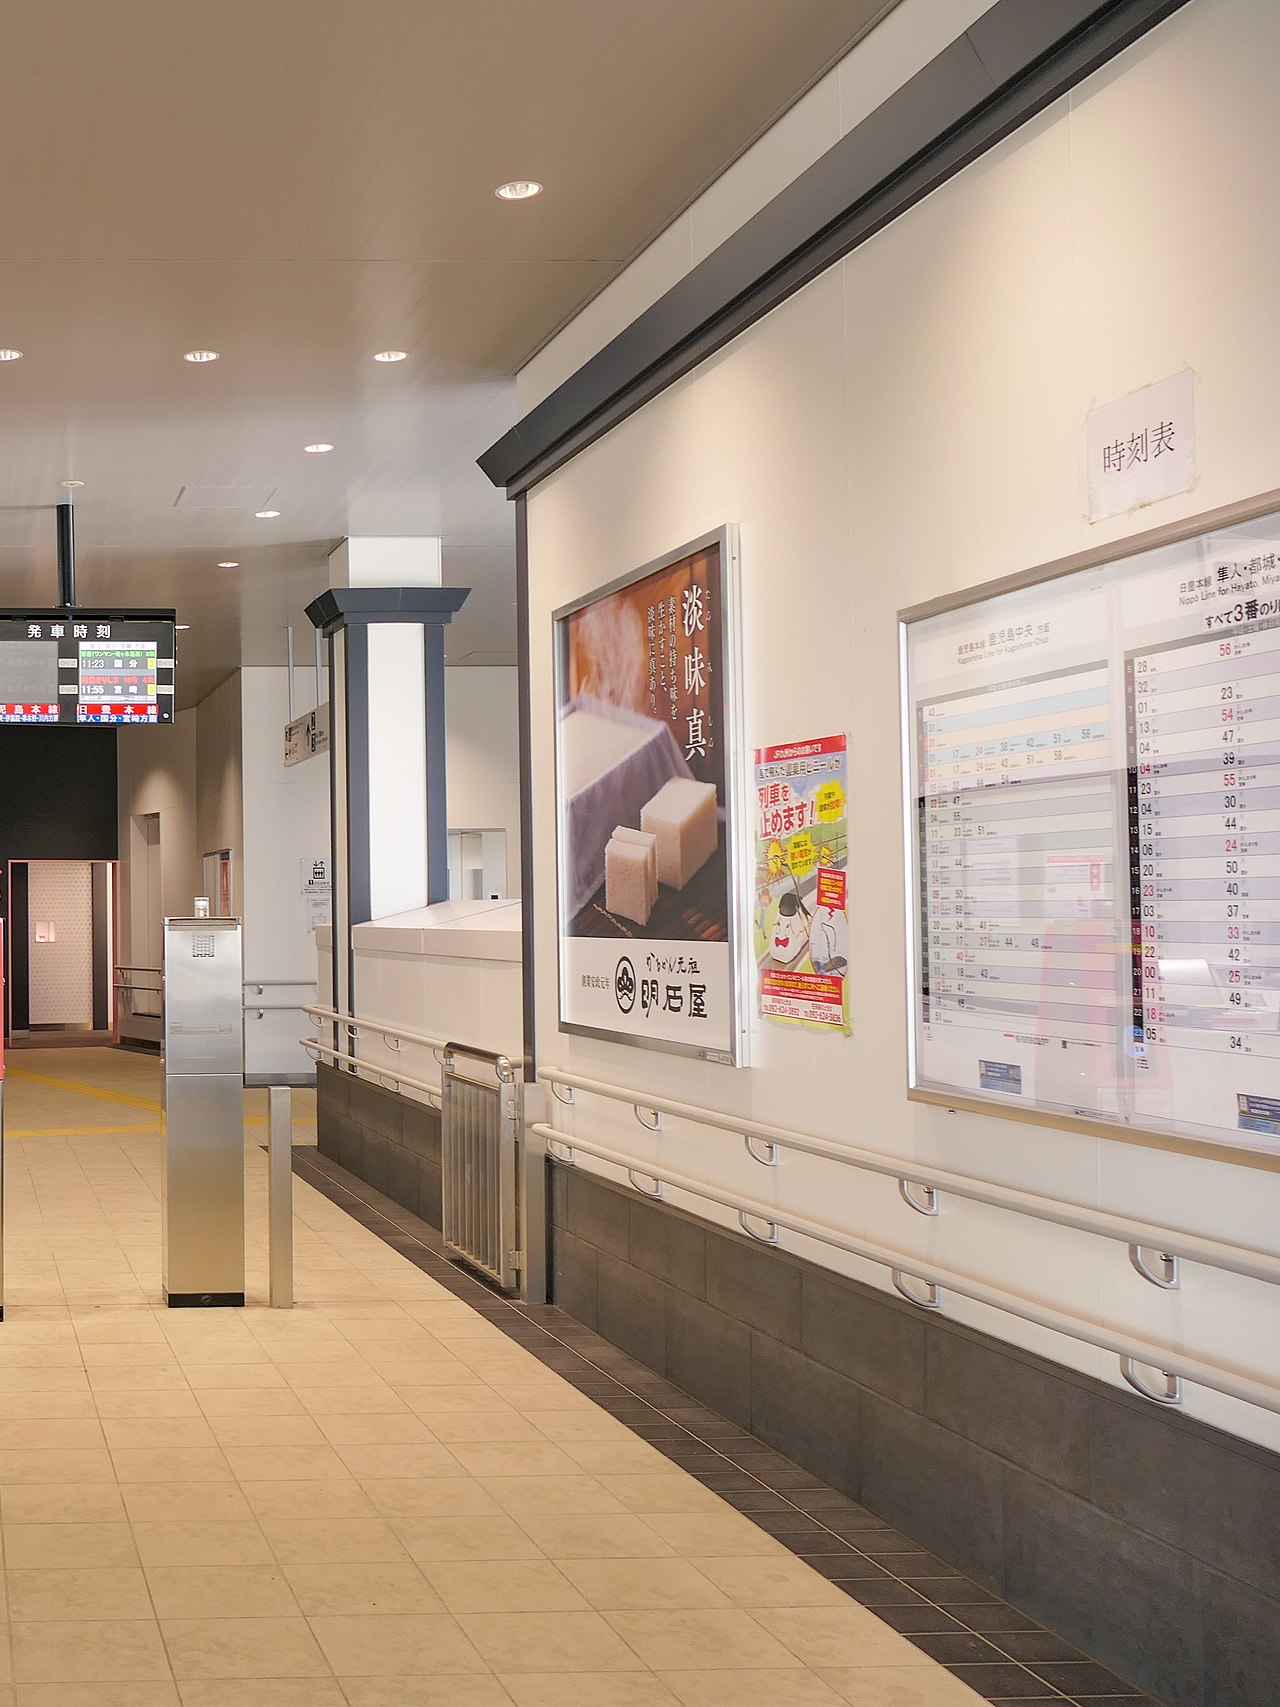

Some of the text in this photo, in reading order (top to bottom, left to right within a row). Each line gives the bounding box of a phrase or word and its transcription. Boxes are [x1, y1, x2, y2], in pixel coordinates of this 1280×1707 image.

[1103, 421, 1175, 473] 時刻表
[1218, 587, 1230, 597] for
[1205, 599, 1280, 629] すべて3番のり
[27, 624, 112, 639] 発車時刻
[82, 659, 105, 668] 11:23
[114, 659, 138, 668] 国分
[1137, 661, 1148, 673] 28
[1220, 643, 1231, 656] 56
[682, 584, 707, 761] 淡味真
[81, 685, 105, 694] 11:55
[1137, 681, 1148, 693] 32
[1138, 702, 1148, 713] 01
[1221, 687, 1233, 700] 23
[80, 705, 157, 714] 日豊本線
[1139, 722, 1149, 734] 13
[1222, 708, 1233, 721] 54
[1139, 742, 1150, 754] 04
[1223, 730, 1234, 743] 47
[1140, 763, 1151, 774] 04
[1223, 752, 1235, 765] 39
[1141, 783, 1151, 794] 23
[1224, 773, 1235, 787] 55
[758, 782, 791, 809] 列車を
[1141, 803, 1152, 815] 04
[1224, 795, 1236, 808] 30
[760, 800, 815, 838] 止めます!
[1142, 824, 1152, 835] 15
[1225, 817, 1237, 829] 44
[1142, 844, 1153, 856] 06
[1226, 840, 1237, 852] 24
[1143, 864, 1153, 876] 20
[1226, 861, 1238, 874] 50
[1143, 885, 1154, 896] 23
[1227, 883, 1239, 895] 40
[1144, 905, 1154, 917] 03
[1227, 905, 1239, 917] 37
[1145, 925, 1154, 937] 10
[1228, 927, 1240, 939] 33
[1145, 946, 1155, 957] 22
[1228, 949, 1240, 961] 42
[1145, 966, 1155, 978] 00
[1229, 970, 1241, 983] 25
[641, 979, 708, 1018] 明石屋
[1145, 987, 1155, 999] 11
[1229, 992, 1242, 1005] 49
[1146, 1008, 1157, 1020] 18
[1146, 1028, 1157, 1040] 05
[1230, 1036, 1243, 1049] 34
